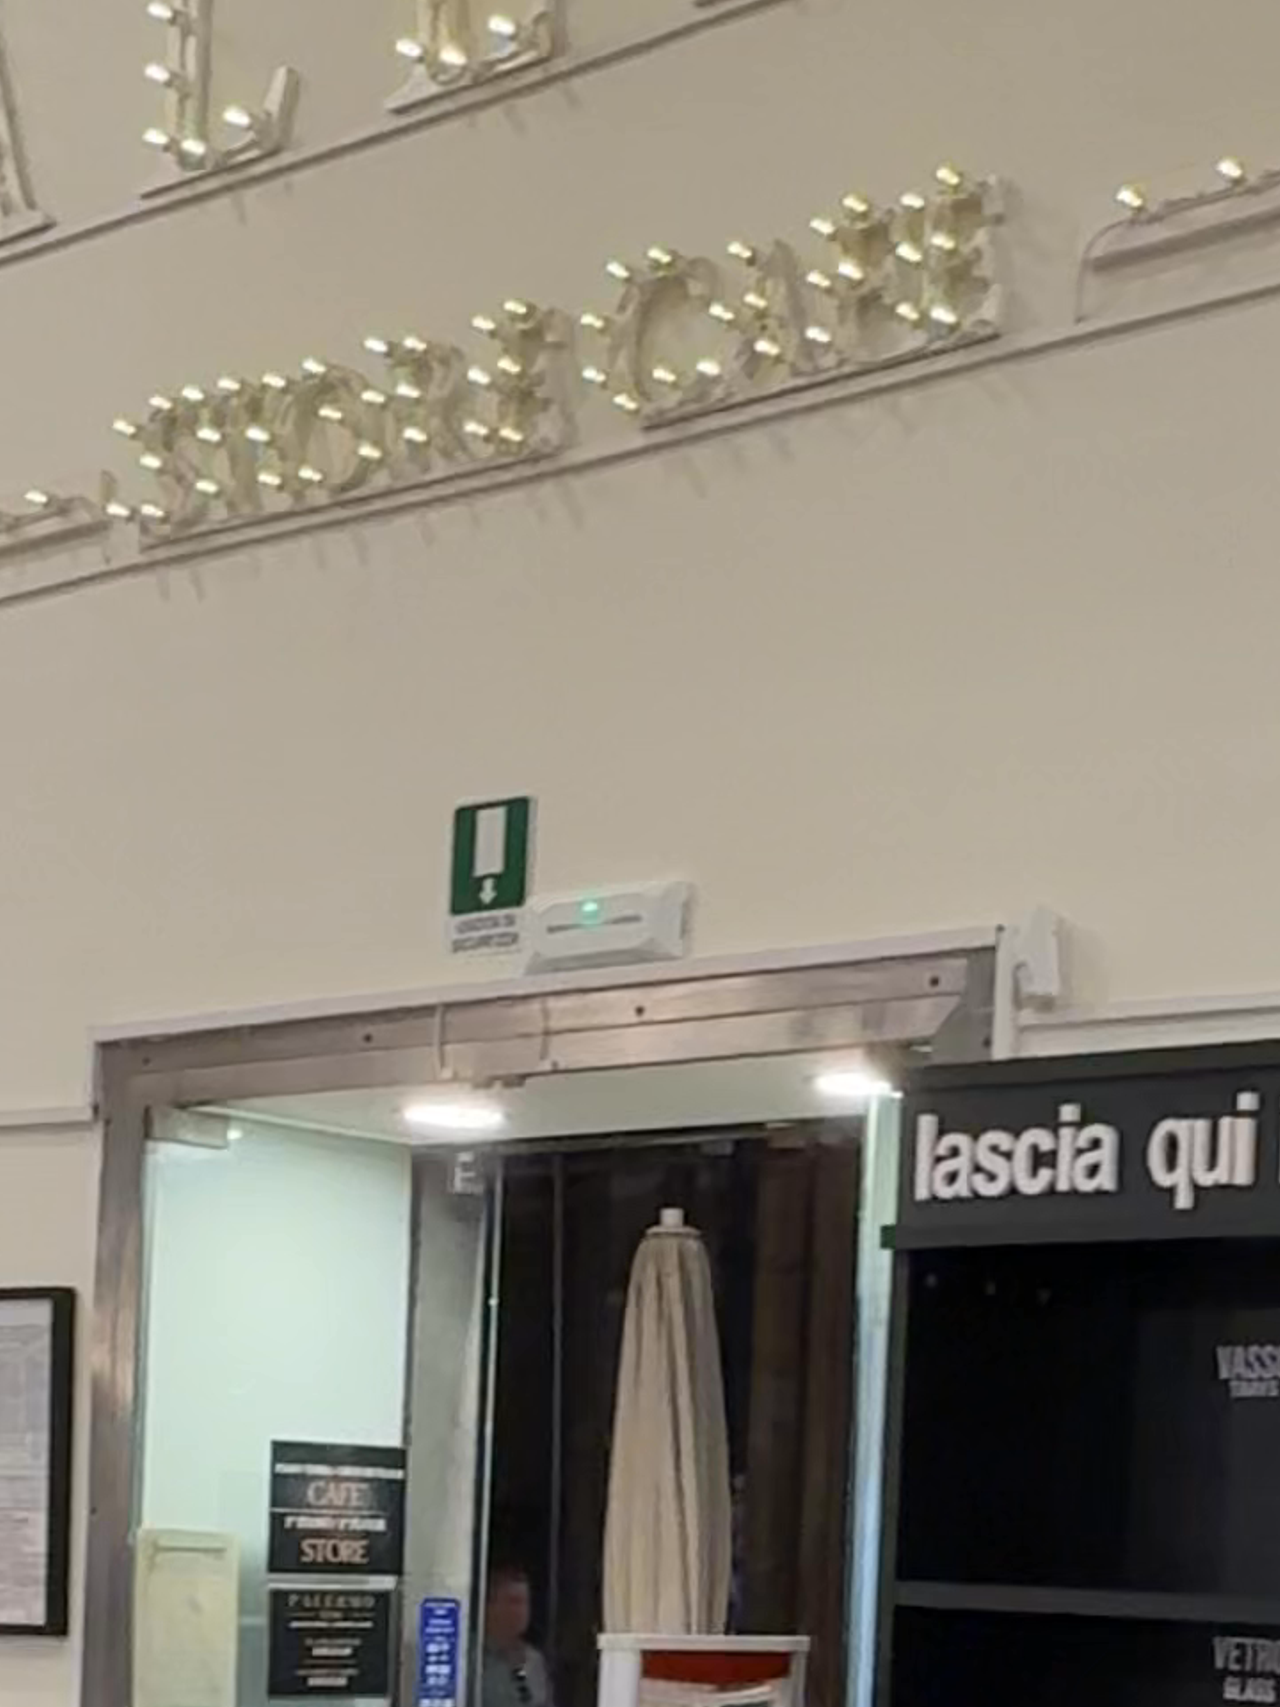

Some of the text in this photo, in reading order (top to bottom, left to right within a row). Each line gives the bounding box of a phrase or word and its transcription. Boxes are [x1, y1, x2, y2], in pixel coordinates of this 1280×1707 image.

[106, 297, 574, 551] STORE
[913, 1102, 1119, 1202] lascia
[1148, 1093, 1259, 1210] qui
[300, 1537, 370, 1565] STORE
